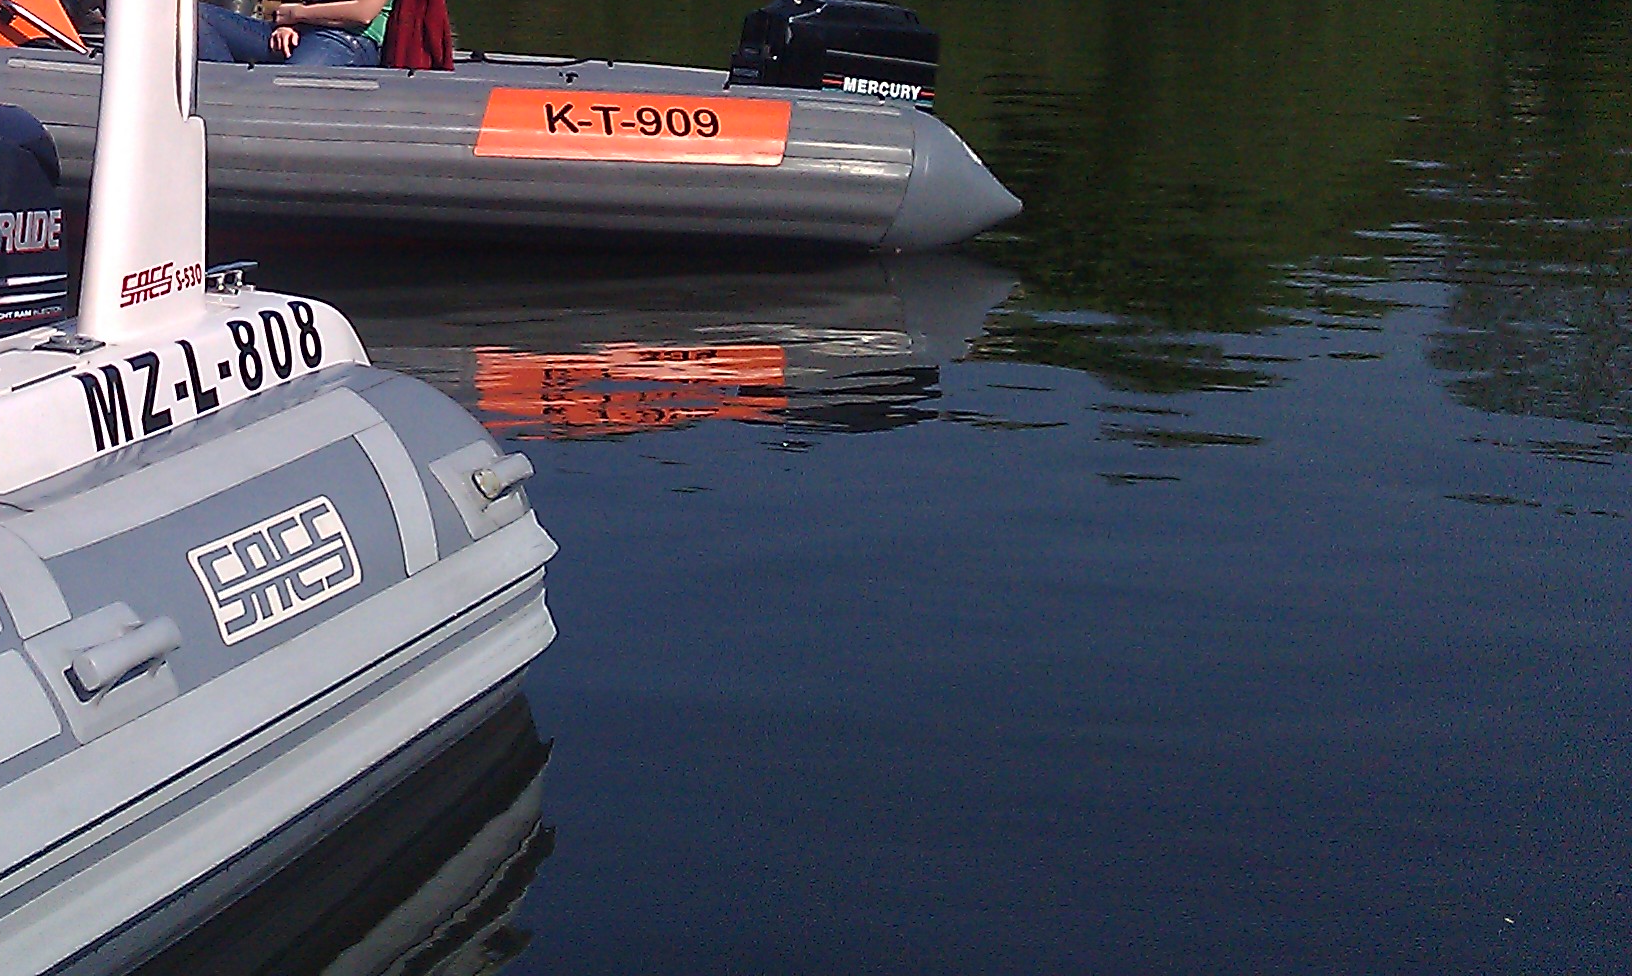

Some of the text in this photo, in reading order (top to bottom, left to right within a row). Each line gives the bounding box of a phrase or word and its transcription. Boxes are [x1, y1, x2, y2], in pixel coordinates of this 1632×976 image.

[843, 76, 922, 101] MERCURY
[544, 103, 720, 138] K-T-909
[175, 263, 203, 292] S-530
[72, 299, 323, 452] MZ-L-808
